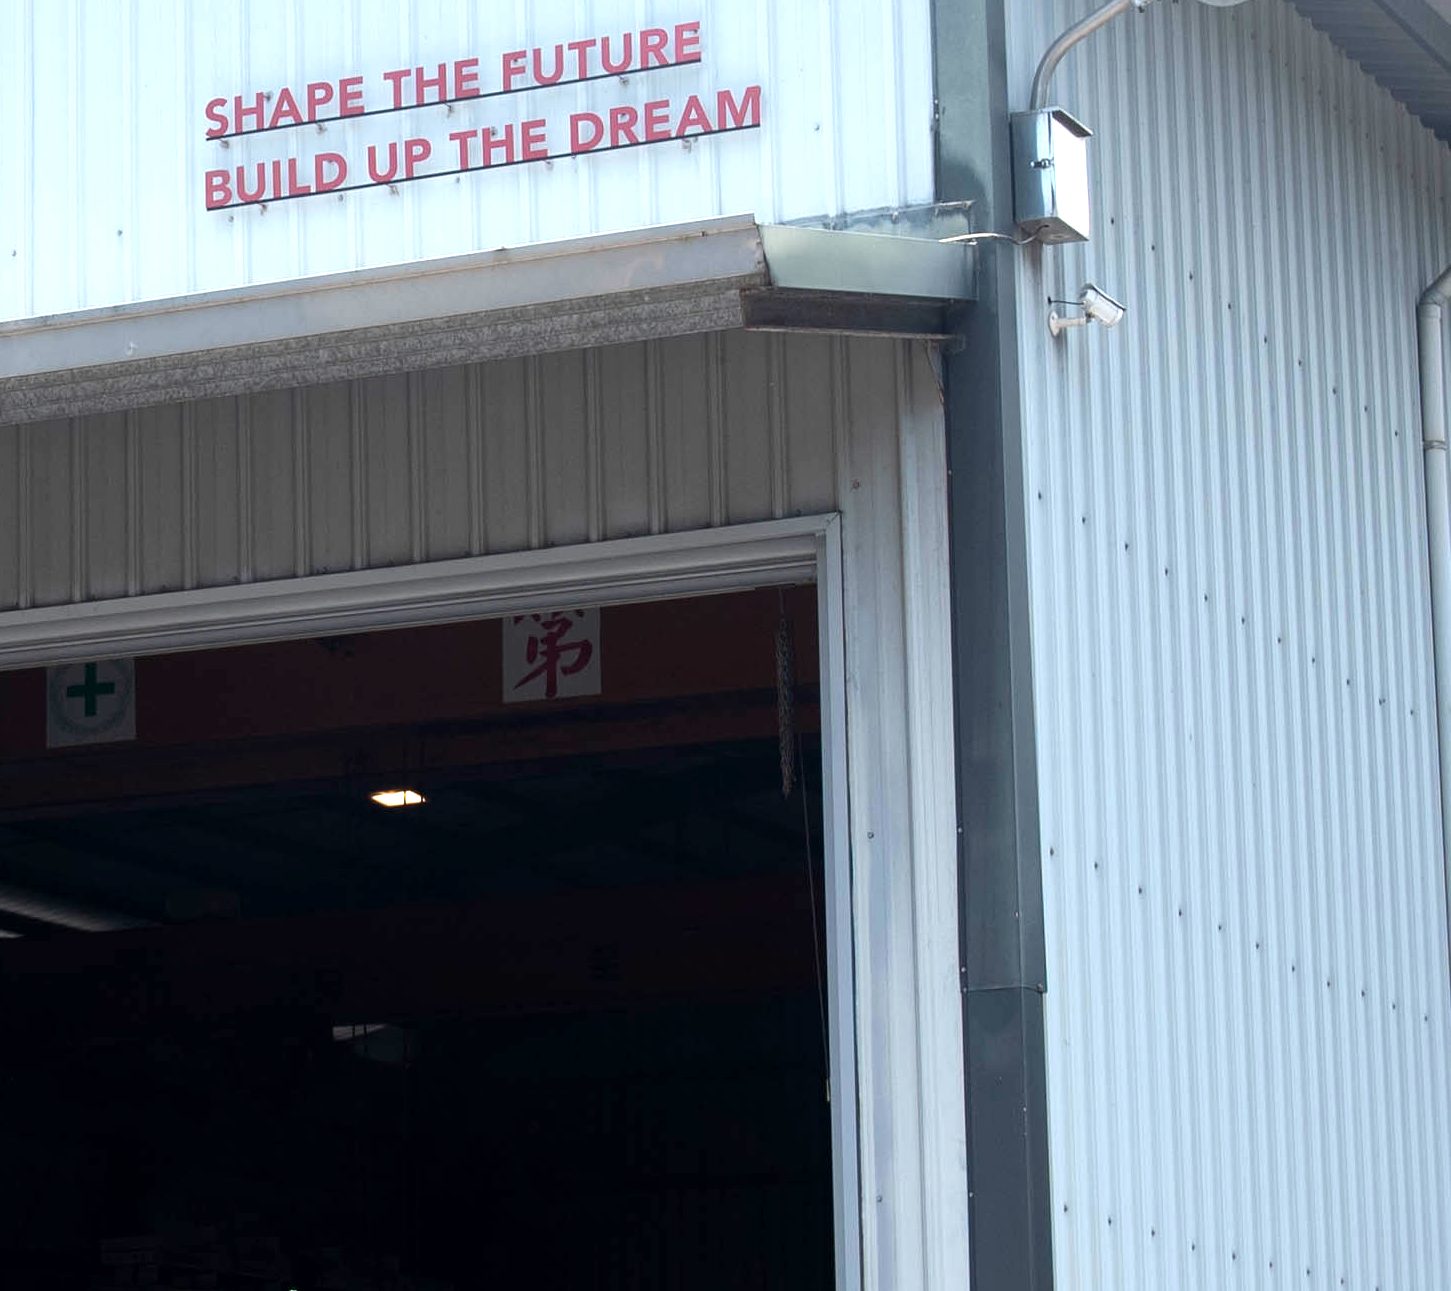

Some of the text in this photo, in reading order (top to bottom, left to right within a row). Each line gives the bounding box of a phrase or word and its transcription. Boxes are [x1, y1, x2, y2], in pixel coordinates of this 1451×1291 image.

[205, 21, 701, 139] SHAPE THE FUTURE
[205, 86, 761, 209] BUILD UP THE DREAM
